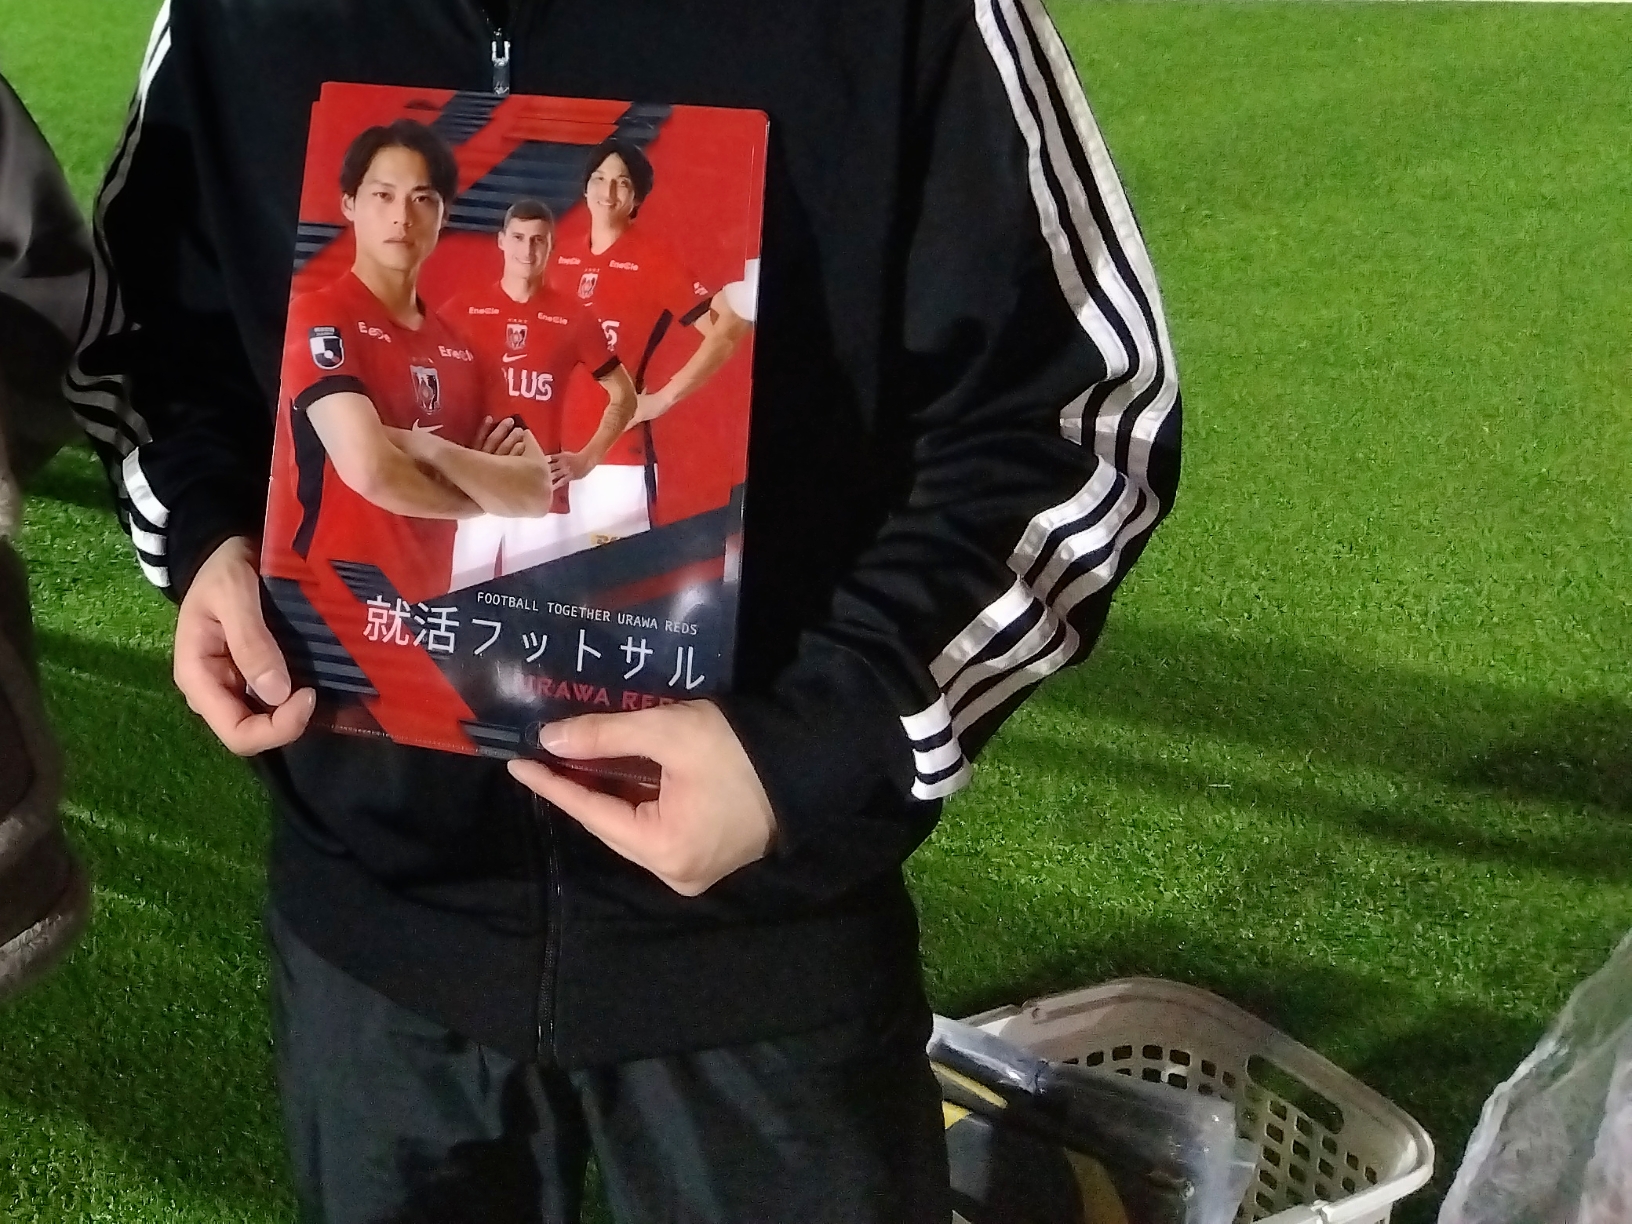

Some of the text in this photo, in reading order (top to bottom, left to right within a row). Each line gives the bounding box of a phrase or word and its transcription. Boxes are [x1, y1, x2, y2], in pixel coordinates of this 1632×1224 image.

[501, 367, 553, 401] LUS
[477, 591, 698, 636] FOOTBALL TOGETHER URAWA REDS
[362, 595, 706, 690] 就活フットサル
